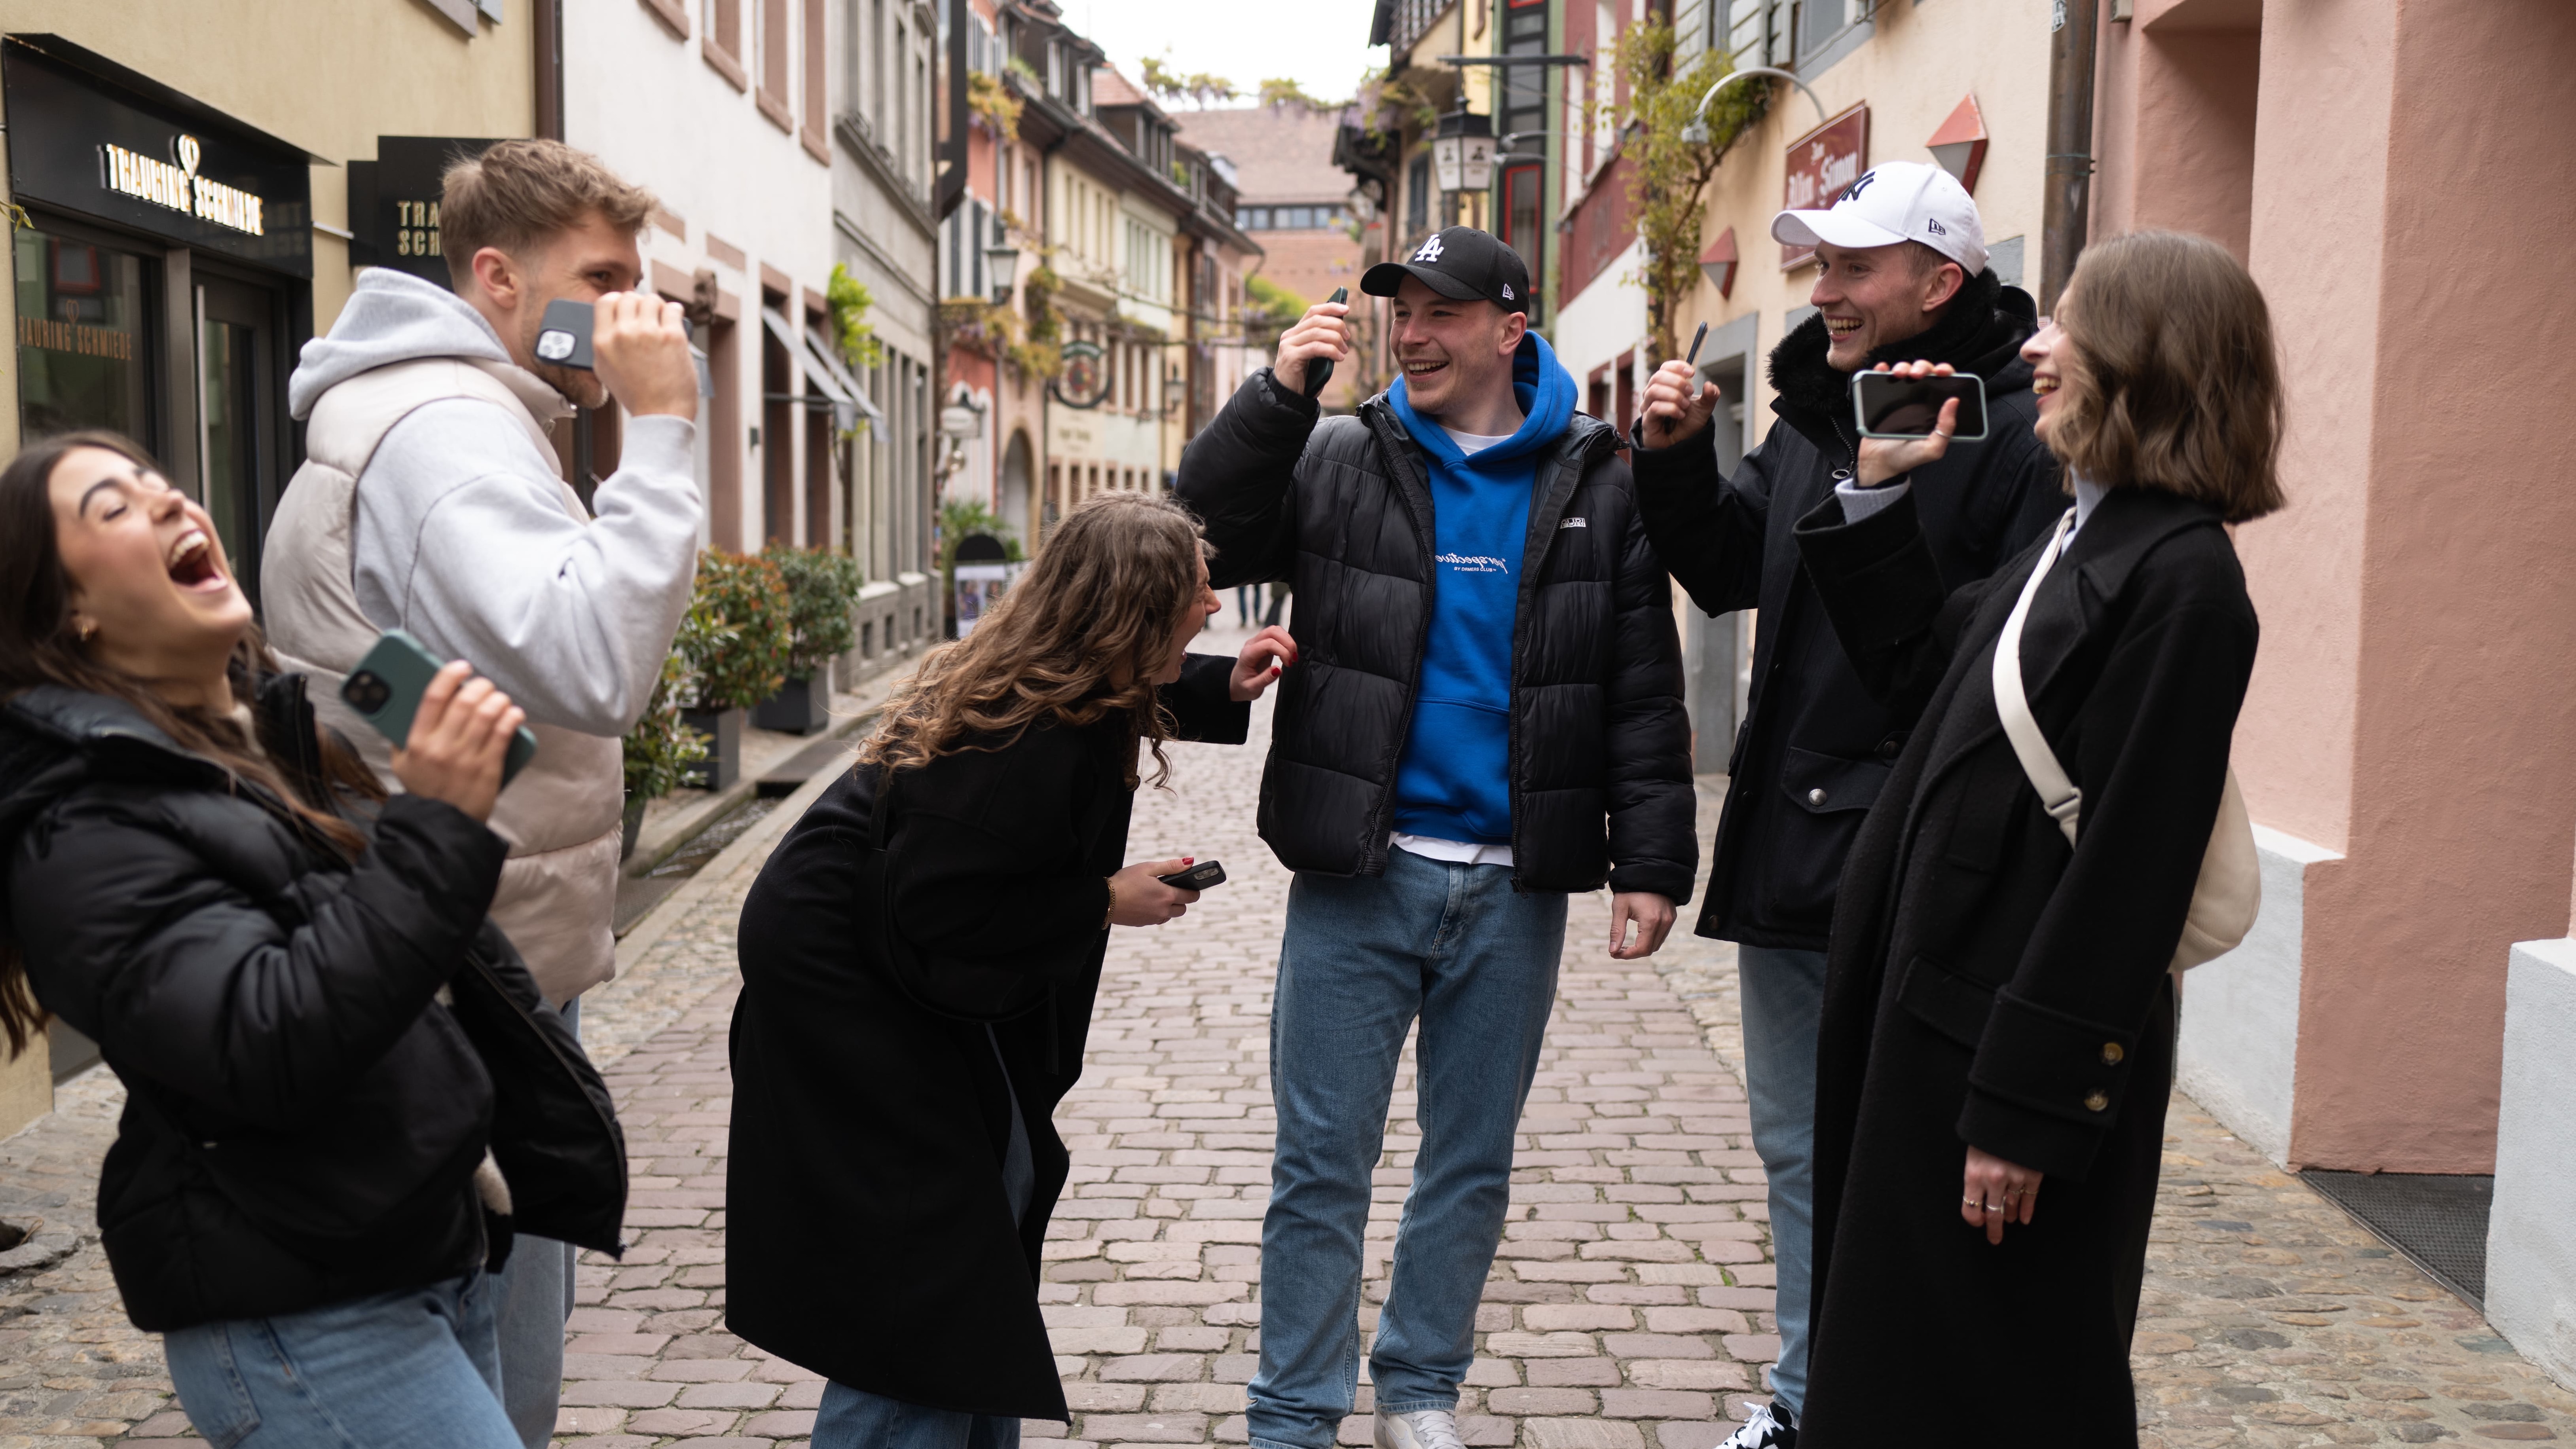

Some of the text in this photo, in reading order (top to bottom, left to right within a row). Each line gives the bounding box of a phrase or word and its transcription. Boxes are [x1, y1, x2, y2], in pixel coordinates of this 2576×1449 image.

[106, 143, 192, 212] TRAURING
[396, 201, 439, 227] TRA
[397, 228, 440, 256] SCH
[1415, 234, 1444, 262] LA
[77, 324, 132, 360] SCHMIEDE
